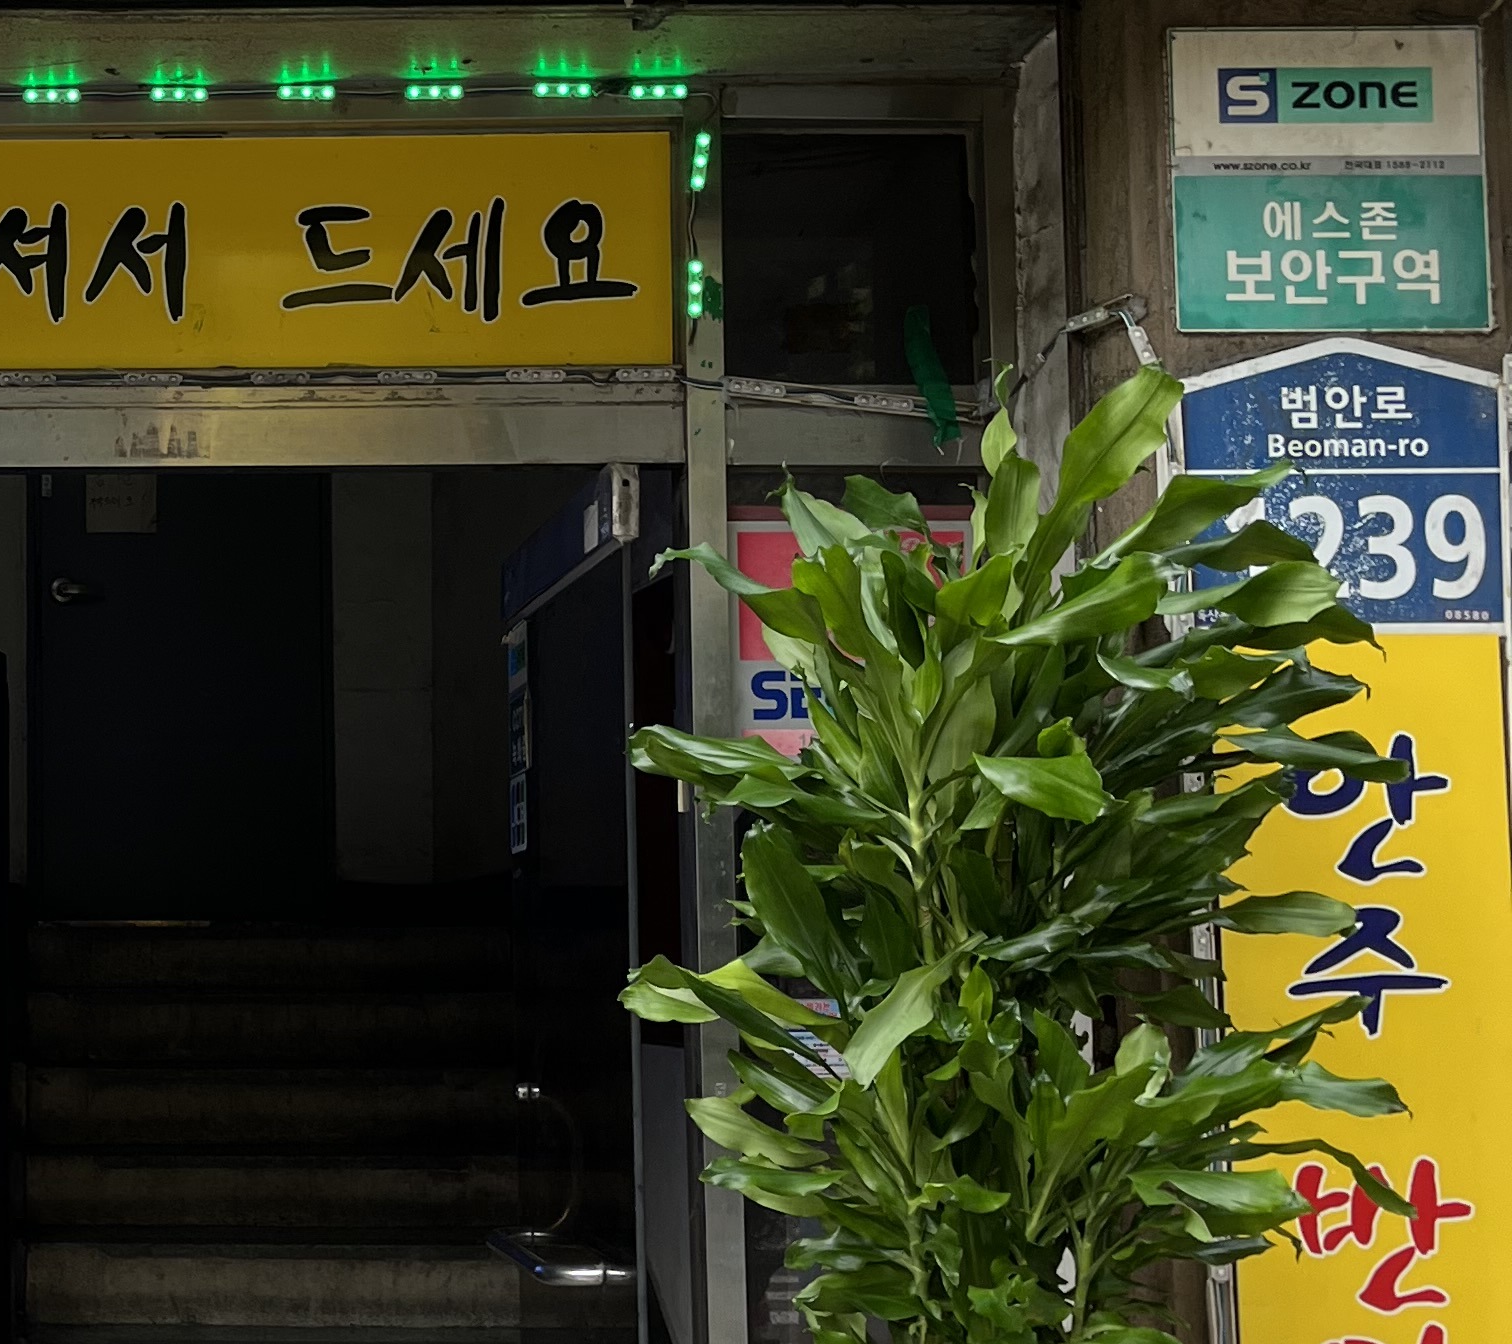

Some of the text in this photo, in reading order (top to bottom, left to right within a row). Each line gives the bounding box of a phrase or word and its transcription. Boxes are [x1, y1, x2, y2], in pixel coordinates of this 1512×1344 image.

[1213, 160, 1312, 171] www.szone.co.kr
[1262, 200, 1399, 243] 에스존
[283, 197, 639, 324] 드세요
[1224, 248, 1442, 306] 보안구역
[1280, 384, 1414, 431] 범안로
[1267, 433, 1430, 459] Beoman-ro
[1280, 731, 1451, 1038] 안주
